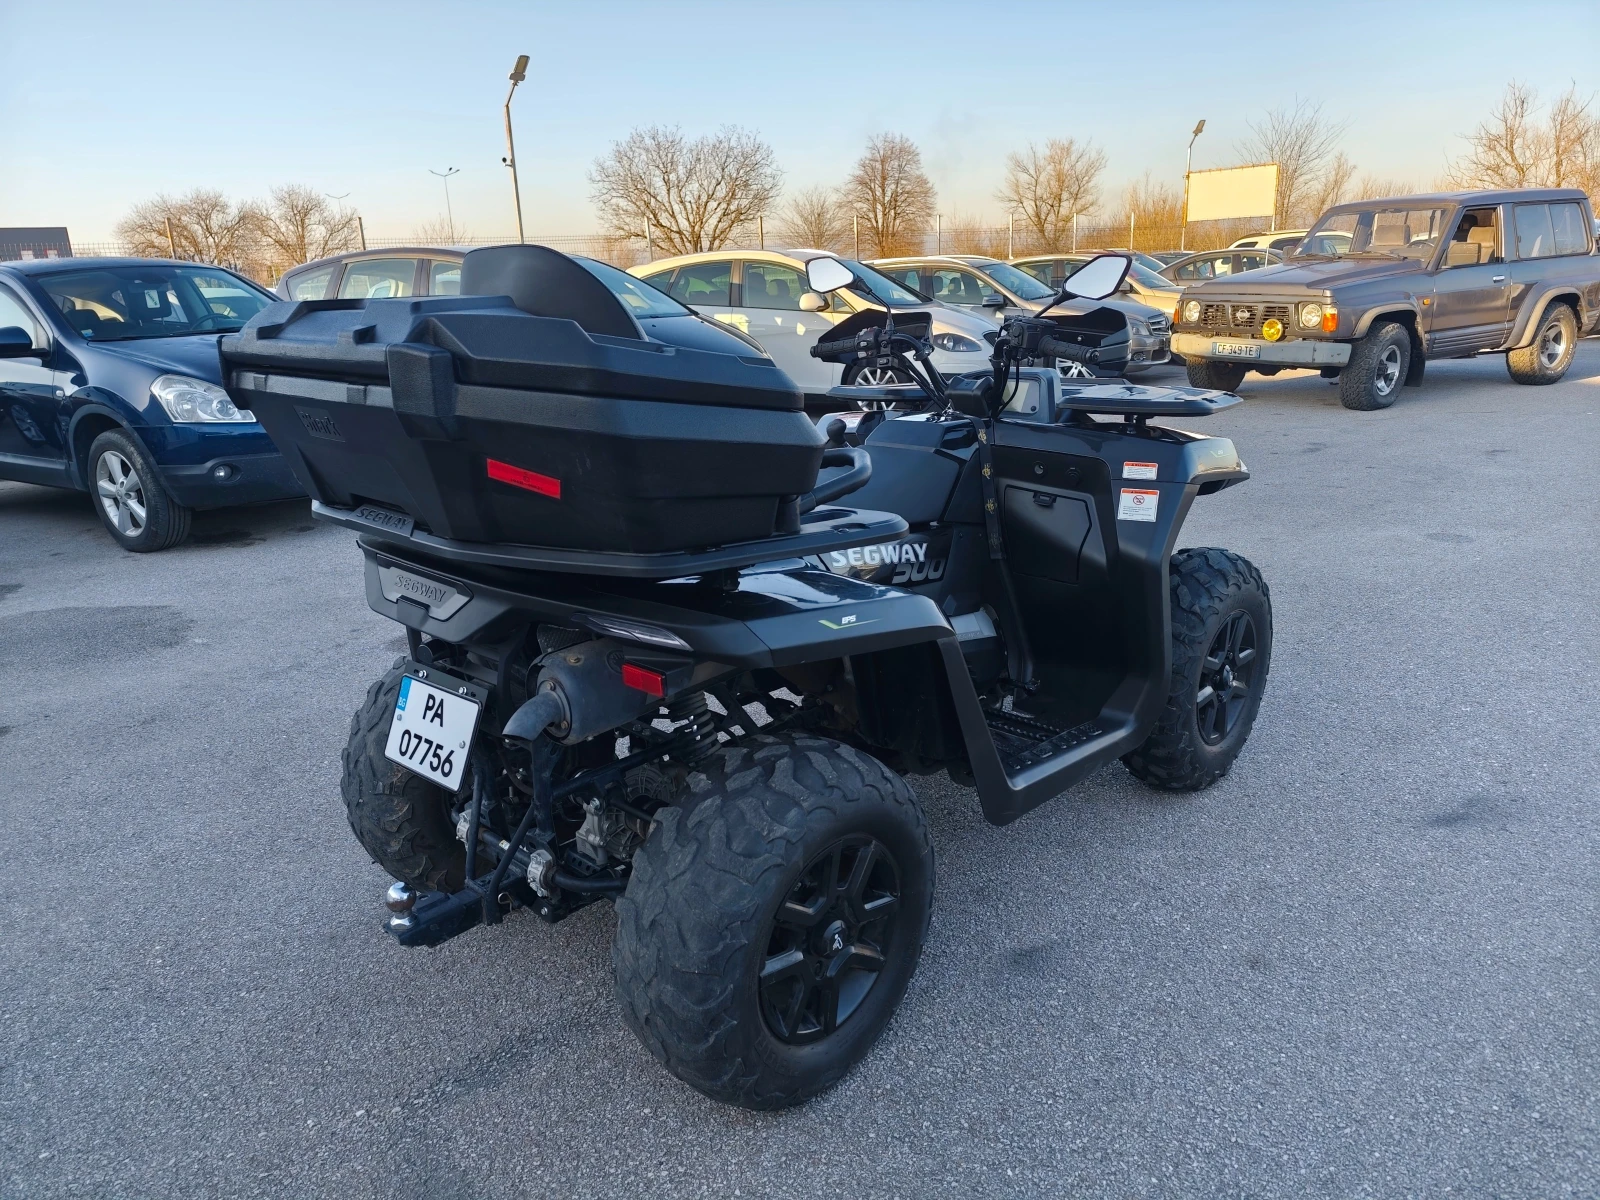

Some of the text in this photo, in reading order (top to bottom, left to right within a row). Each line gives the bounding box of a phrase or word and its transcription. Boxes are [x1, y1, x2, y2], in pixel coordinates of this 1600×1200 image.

[356, 507, 412, 530] SEGWAY
[829, 542, 929, 568] SEGWAY
[394, 574, 447, 603] SEGWAY
[422, 693, 444, 728] PA
[399, 729, 455, 778] 07756
